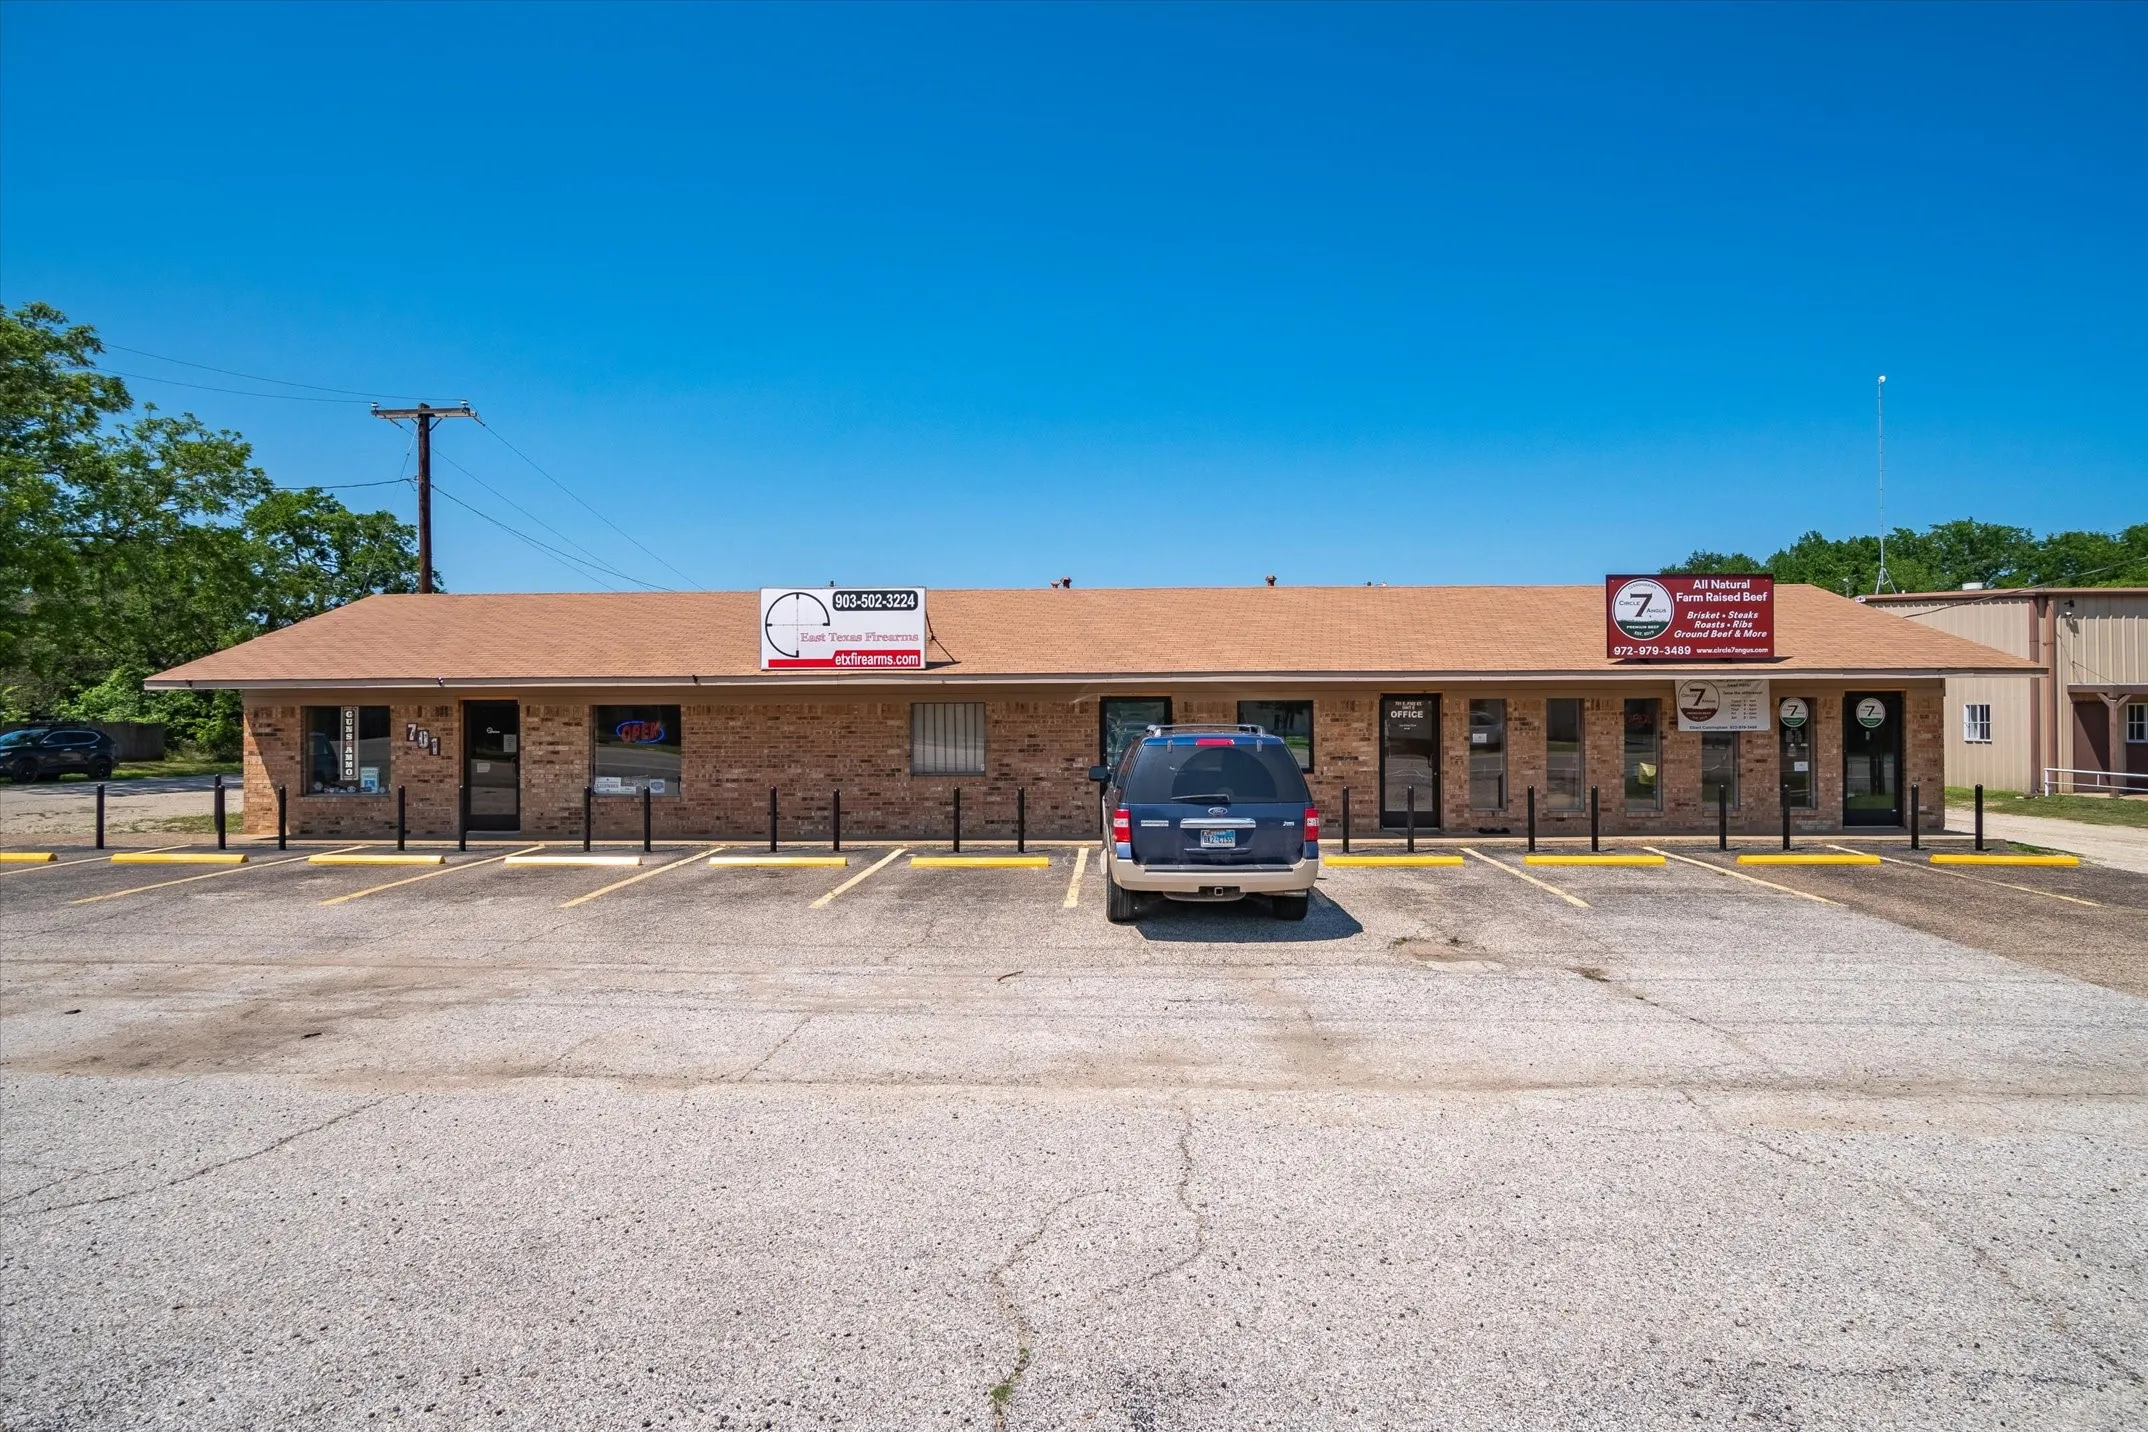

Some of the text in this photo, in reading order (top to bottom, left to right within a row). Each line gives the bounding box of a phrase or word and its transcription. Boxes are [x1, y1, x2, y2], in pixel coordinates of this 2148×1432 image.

[1693, 579, 1750, 590] All Natural
[835, 593, 916, 608] 903-502-3224
[1676, 591, 1768, 602] Farm Raised Beef
[1630, 593, 1653, 618] 7
[1687, 611, 1759, 619] Brisket Steaks
[1694, 620, 1753, 629] Roasts Ribs
[800, 632, 919, 643] East Texas Firearms
[1674, 629, 1768, 638] Ground Beef & More
[1613, 645, 1691, 656] 972-979-3489
[1696, 646, 1769, 655] www.circle7angus.com
[835, 652, 919, 666] etxfirearms.com
[1689, 688, 1706, 706] 7
[1390, 710, 1424, 719] OFFICE
[1788, 704, 1798, 716] 7
[1865, 705, 1875, 717] 7
[345, 711, 353, 740] GUNS
[407, 723, 438, 755] 701
[621, 722, 660, 744] OPEN
[345, 746, 353, 776] AMMO
